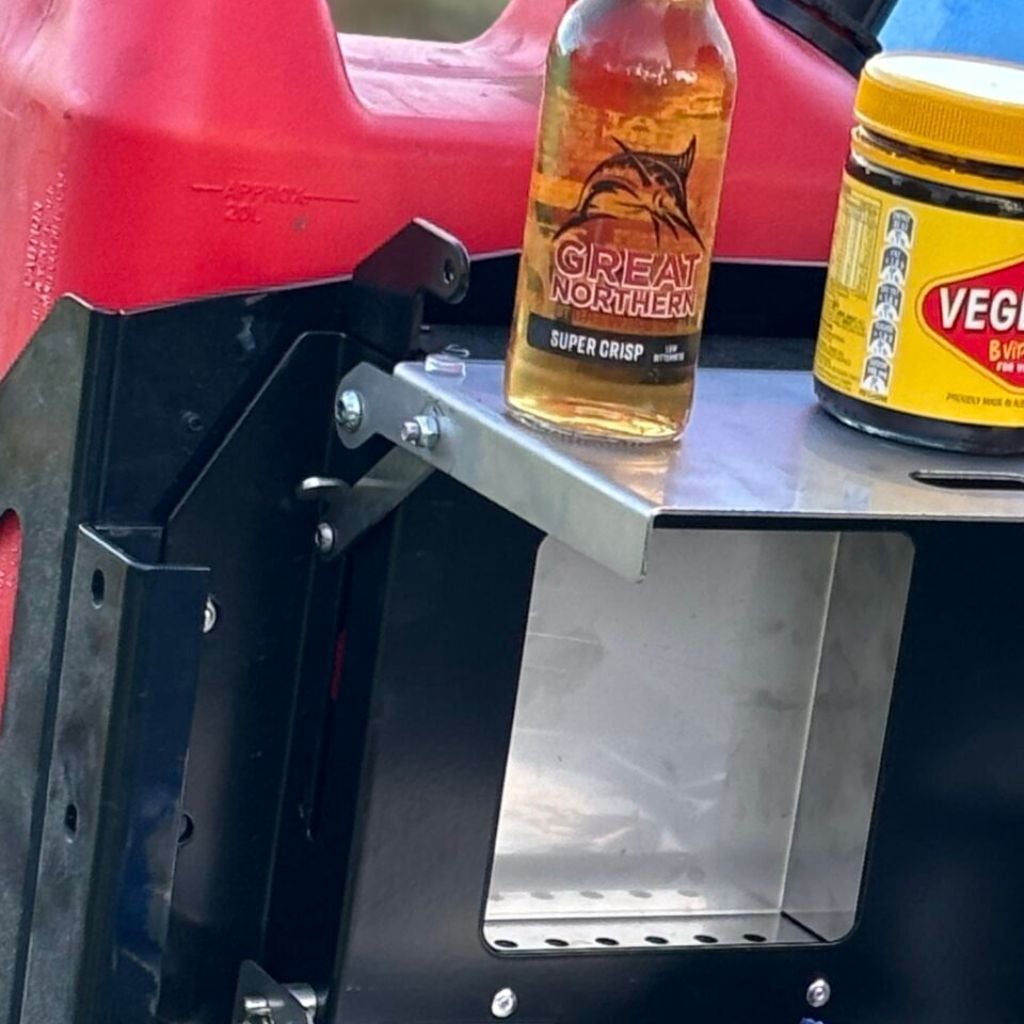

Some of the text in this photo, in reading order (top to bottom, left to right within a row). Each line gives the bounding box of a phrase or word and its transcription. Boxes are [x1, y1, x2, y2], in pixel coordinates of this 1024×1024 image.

[554, 239, 702, 291] GREAT
[551, 274, 698, 319] NORTHERN
[551, 329, 644, 363] SUPER CRISP
[989, 339, 1001, 363] B
